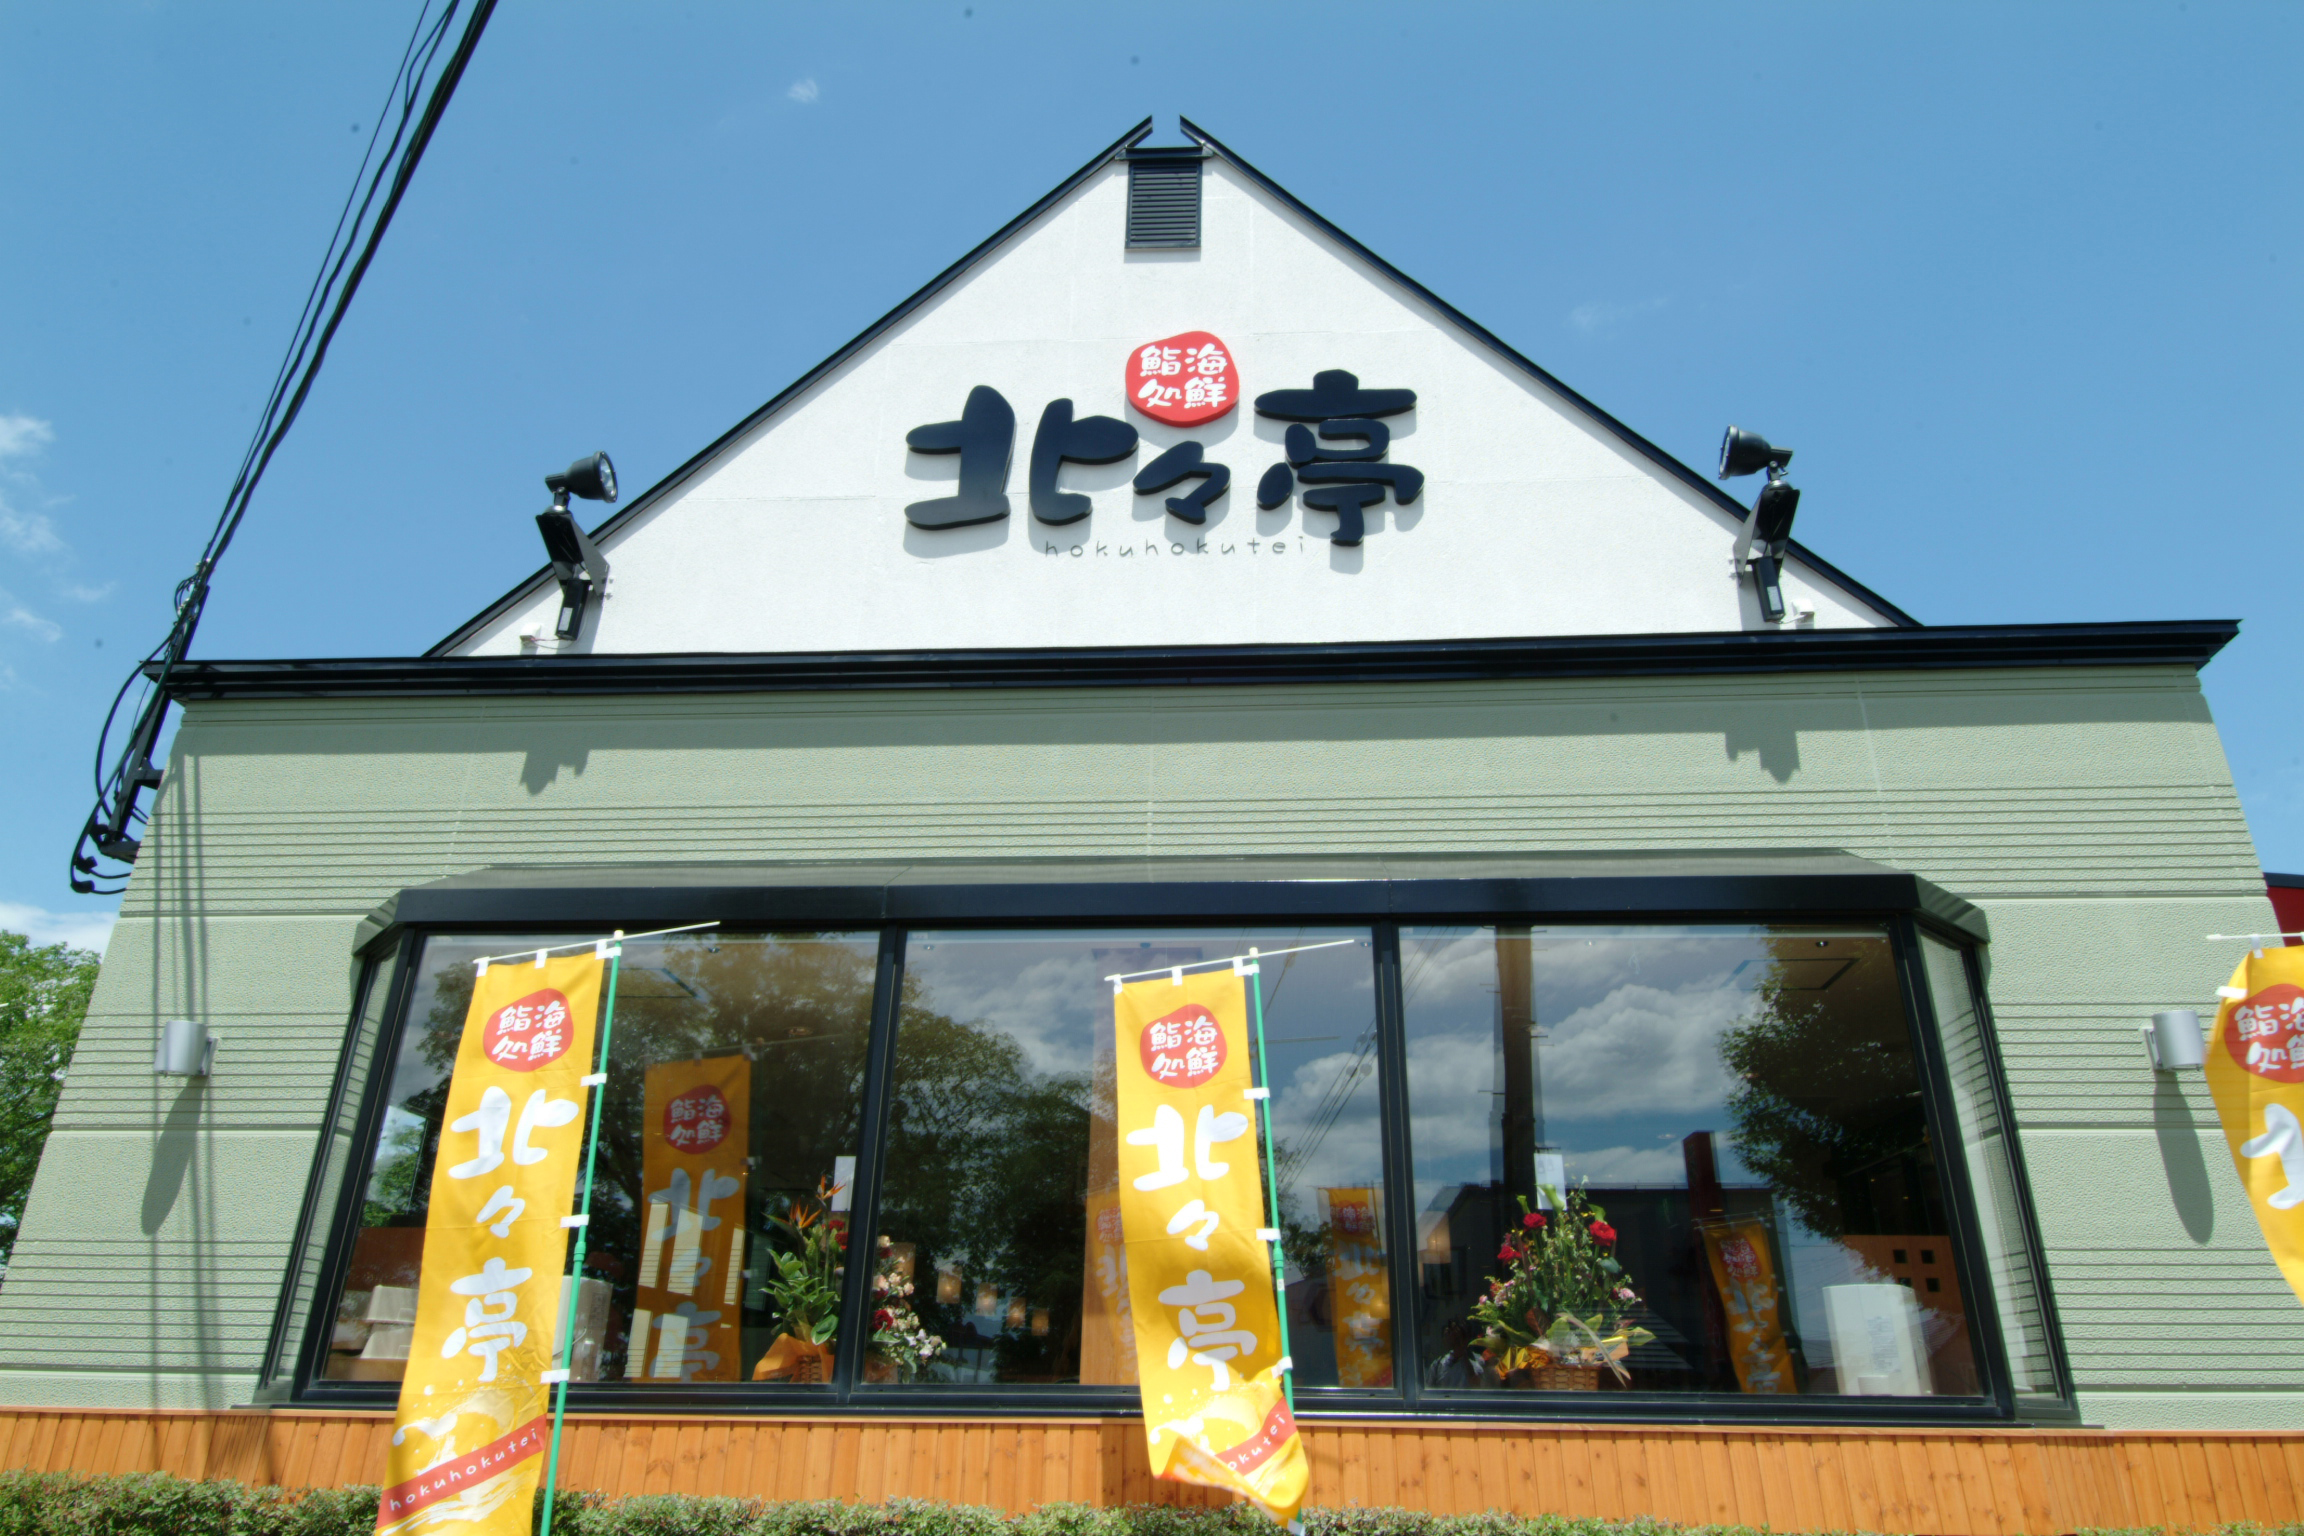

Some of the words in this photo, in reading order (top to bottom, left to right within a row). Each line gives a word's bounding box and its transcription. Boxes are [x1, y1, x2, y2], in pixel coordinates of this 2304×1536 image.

[905, 368, 1425, 547] 北々亭
[1045, 536, 1304, 557] hokuhokutei
[441, 1085, 580, 1382] 北々亭
[1125, 1103, 1258, 1391] 北々亭
[389, 1427, 538, 1512] hokuhokutei
